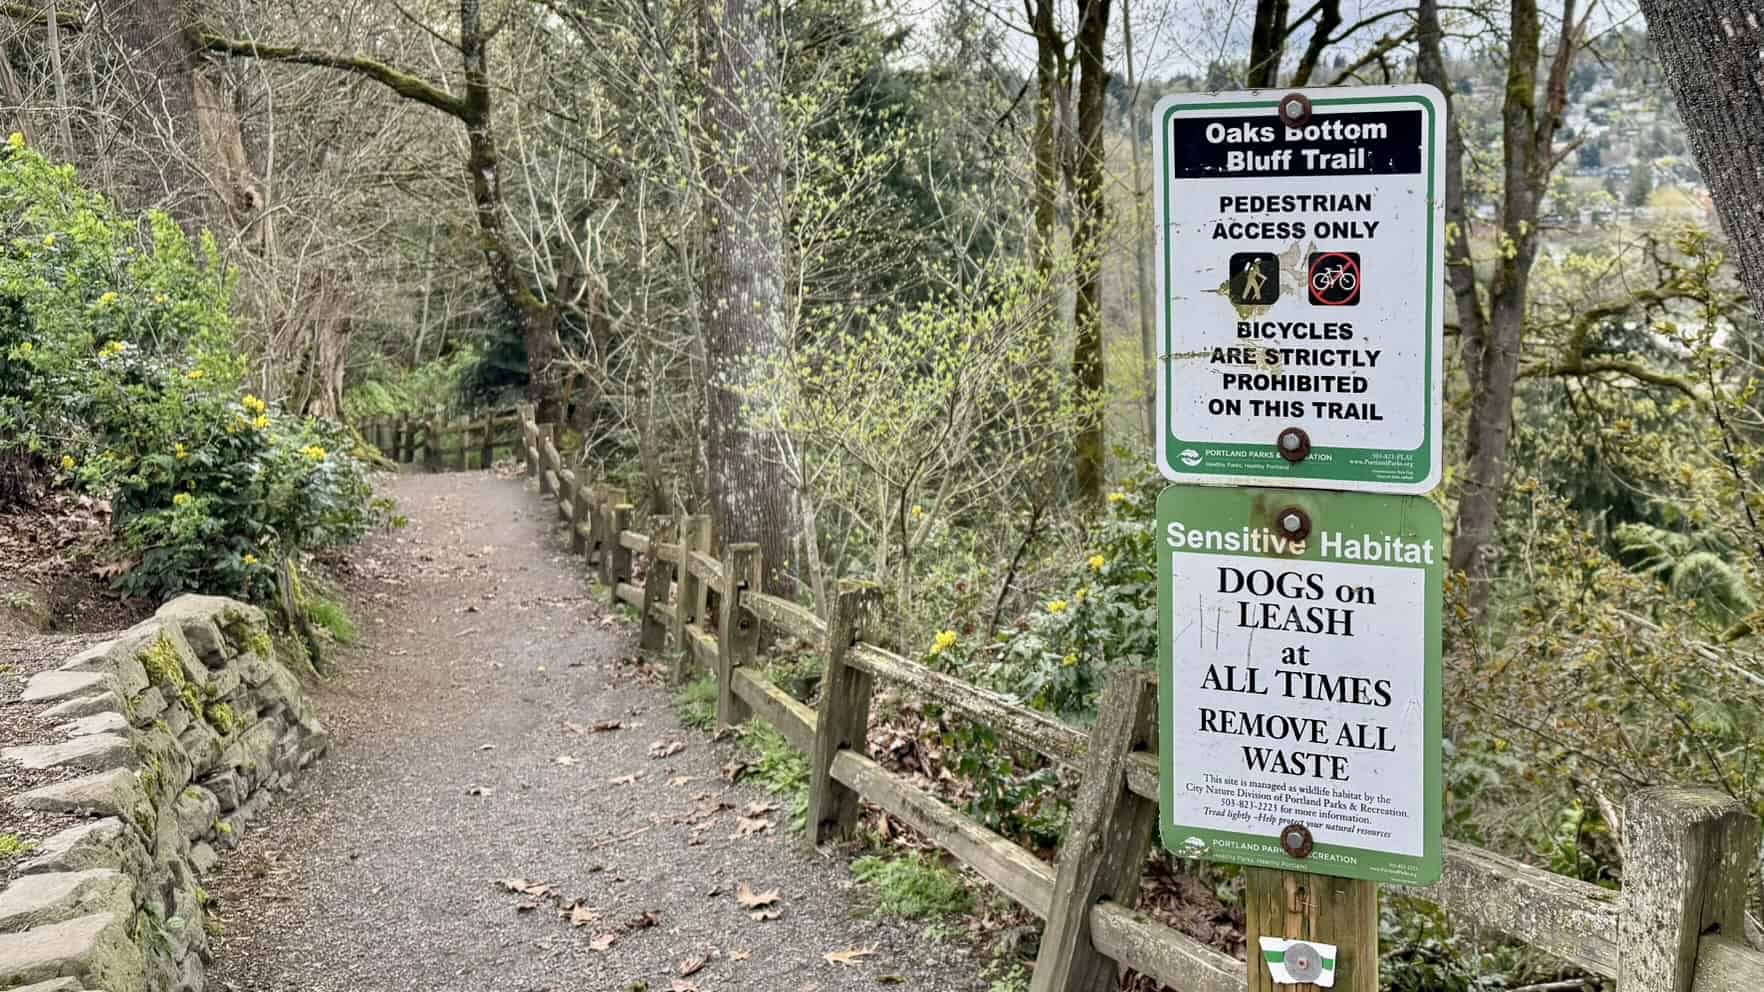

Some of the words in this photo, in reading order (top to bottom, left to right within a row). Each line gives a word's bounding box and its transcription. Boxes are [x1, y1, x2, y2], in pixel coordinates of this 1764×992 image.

[1205, 122, 1275, 144] Oaks
[1285, 120, 1388, 142] Bottom
[1227, 149, 1293, 172] Bluff
[1301, 148, 1365, 170] Trail
[1220, 194, 1372, 213] PEDESTRIAN
[1212, 221, 1306, 240] ACCESS
[1314, 221, 1380, 239] ONLY
[1236, 322, 1353, 340] BICYCLES
[1210, 347, 1257, 365] ARE
[1264, 348, 1382, 368] STRICTLY
[1223, 373, 1369, 394] PROHIBITED
[1208, 399, 1241, 416] ON
[1249, 400, 1305, 418] THIS
[1312, 401, 1383, 421] TRAIL
[1205, 449, 1247, 458] PORTLAND
[1249, 451, 1274, 459] PARKS
[1166, 521, 1306, 555] Sensitive
[1320, 531, 1434, 565] Habitat
[1217, 566, 1324, 600] DOGS
[1335, 584, 1376, 605] on
[1237, 601, 1355, 637] LEASH
[1281, 644, 1310, 667] at
[1200, 663, 1268, 695] ALL
[1274, 669, 1392, 707] TIMES
[1198, 707, 1329, 745] REMOVE
[1336, 721, 1396, 752] ALL
[1242, 745, 1350, 782] WASTE
[1185, 782, 1203, 794] City
[1206, 784, 1235, 797] Nature
[1237, 788, 1272, 801] Division
[1273, 793, 1282, 802] of
[1285, 793, 1321, 807] Portland
[1323, 798, 1347, 810] Parks
[1349, 803, 1358, 812] &
[1360, 803, 1409, 818] Recreation.
[1203, 773, 1222, 784] This
[1224, 776, 1238, 786] site
[1240, 778, 1247, 787] is
[1249, 780, 1287, 792] managed
[1299, 785, 1330, 796] wildlife
[1332, 788, 1361, 801] habitat
[1364, 792, 1375, 804] by
[1377, 794, 1391, 804] the
[1203, 806, 1226, 817] Tread
[1227, 810, 1251, 823] lightly
[1306, 821, 1323, 829] your
[1325, 822, 1355, 833] natural
[1356, 828, 1392, 839] resources
[1280, 804, 1292, 814] for
[1294, 808, 1318, 818] more
[1319, 810, 1372, 825] information.
[1212, 839, 1260, 852] PORTLAND
